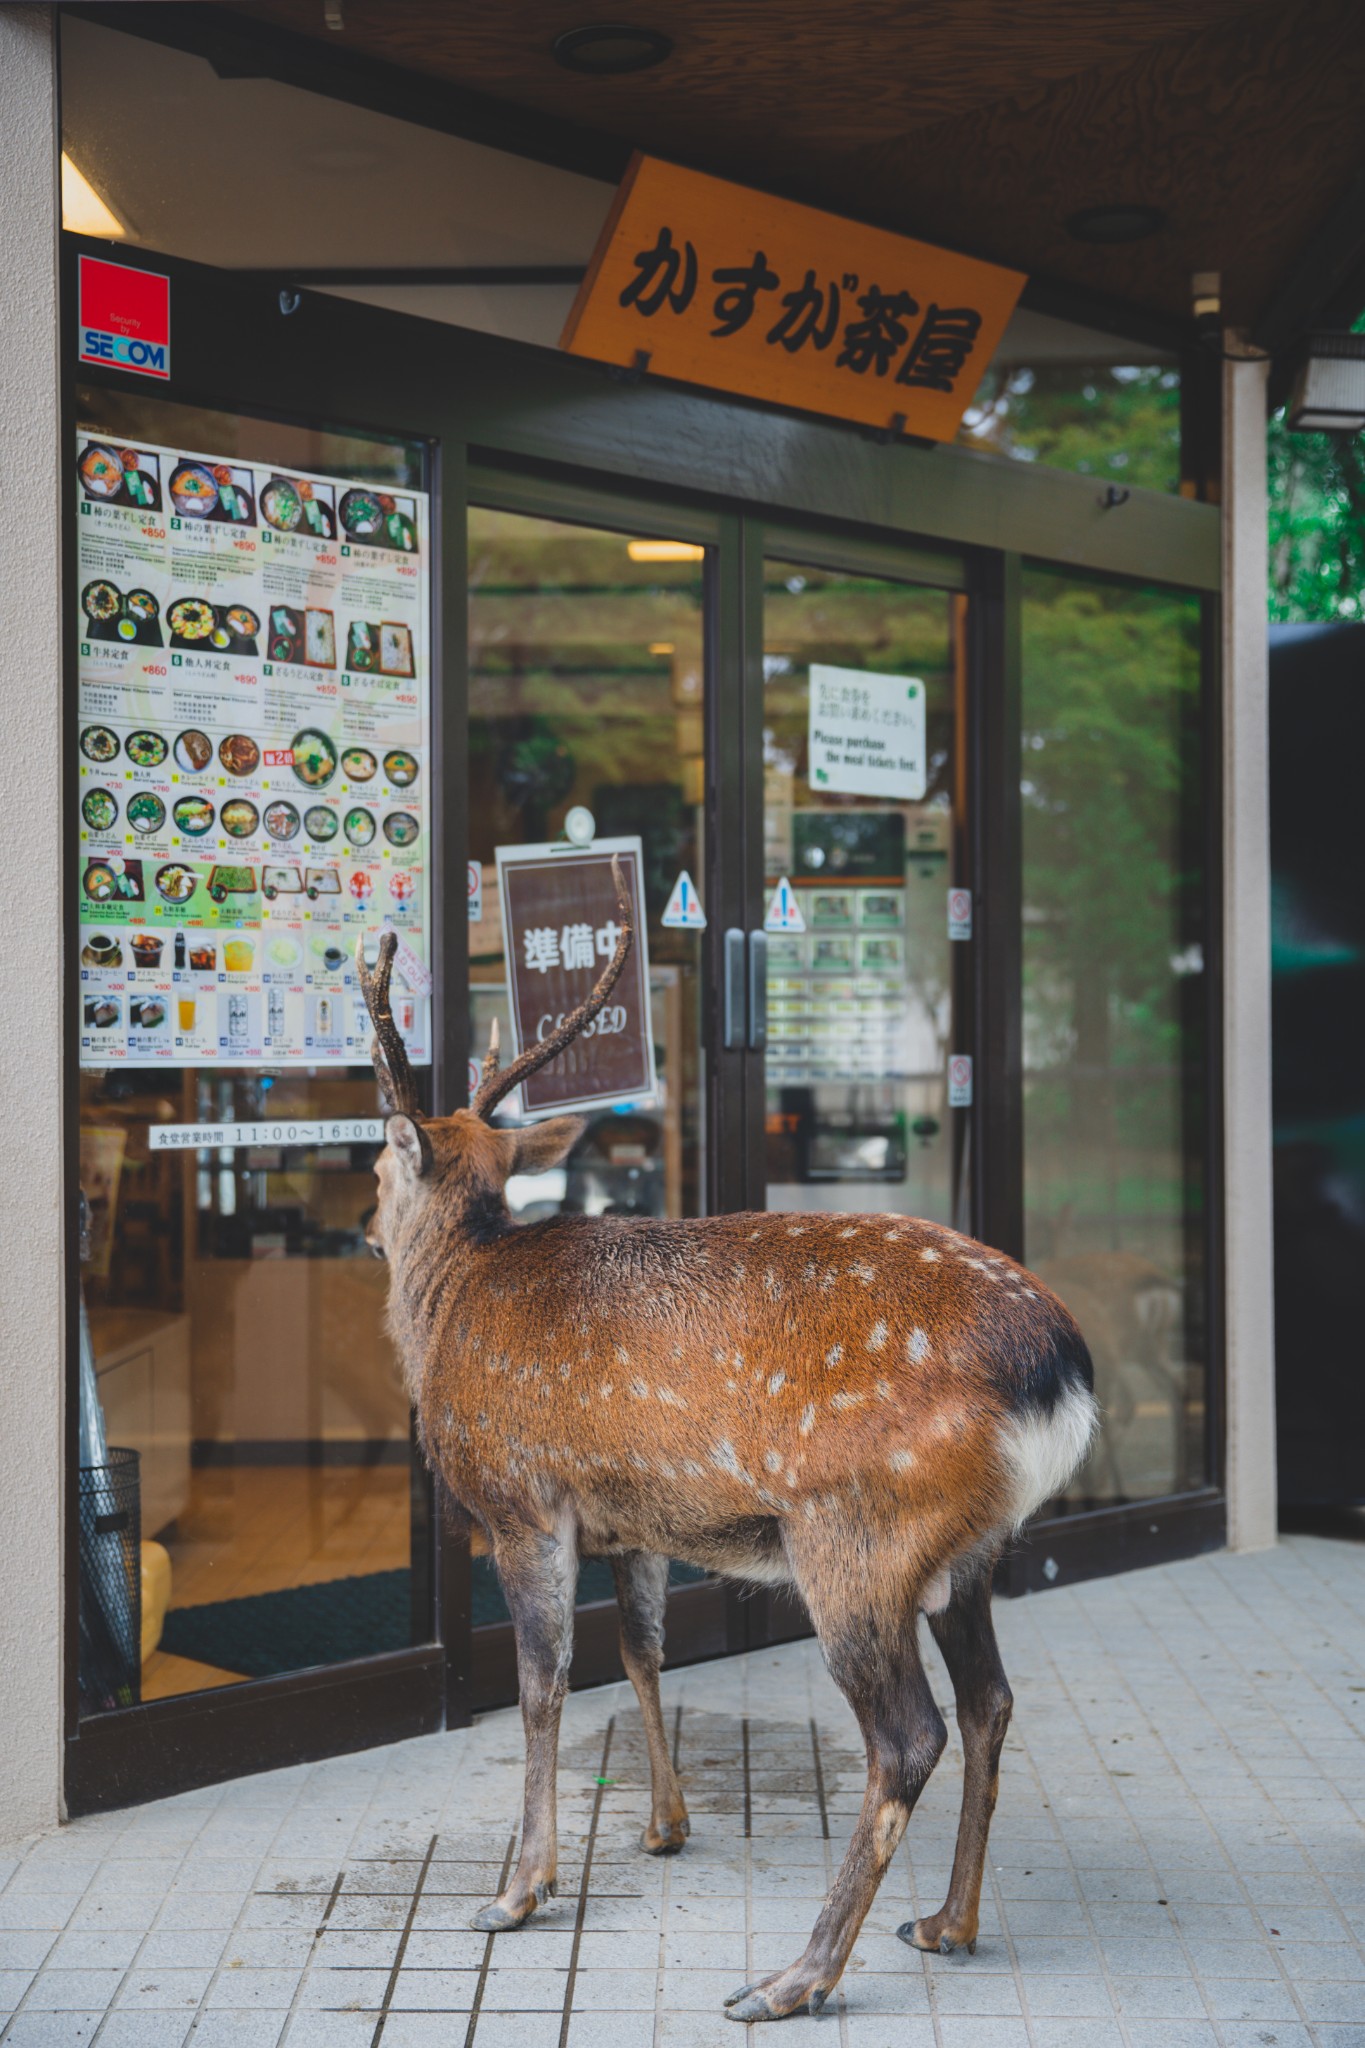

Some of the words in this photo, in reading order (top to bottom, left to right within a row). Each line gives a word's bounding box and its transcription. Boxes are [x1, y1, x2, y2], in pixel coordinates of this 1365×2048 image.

[619, 227, 981, 392] かすが茶屋
[110, 312, 141, 328] Security
[121, 326, 130, 335] by
[85, 331, 164, 369] SECOM
[142, 527, 165, 538] ¥850
[233, 541, 256, 551] ¥890
[142, 665, 167, 676] ¥860
[234, 675, 257, 685] ¥890
[814, 729, 842, 745] Please
[523, 920, 622, 974] 準備中
[158, 1132, 224, 1145] 食堂営業時間
